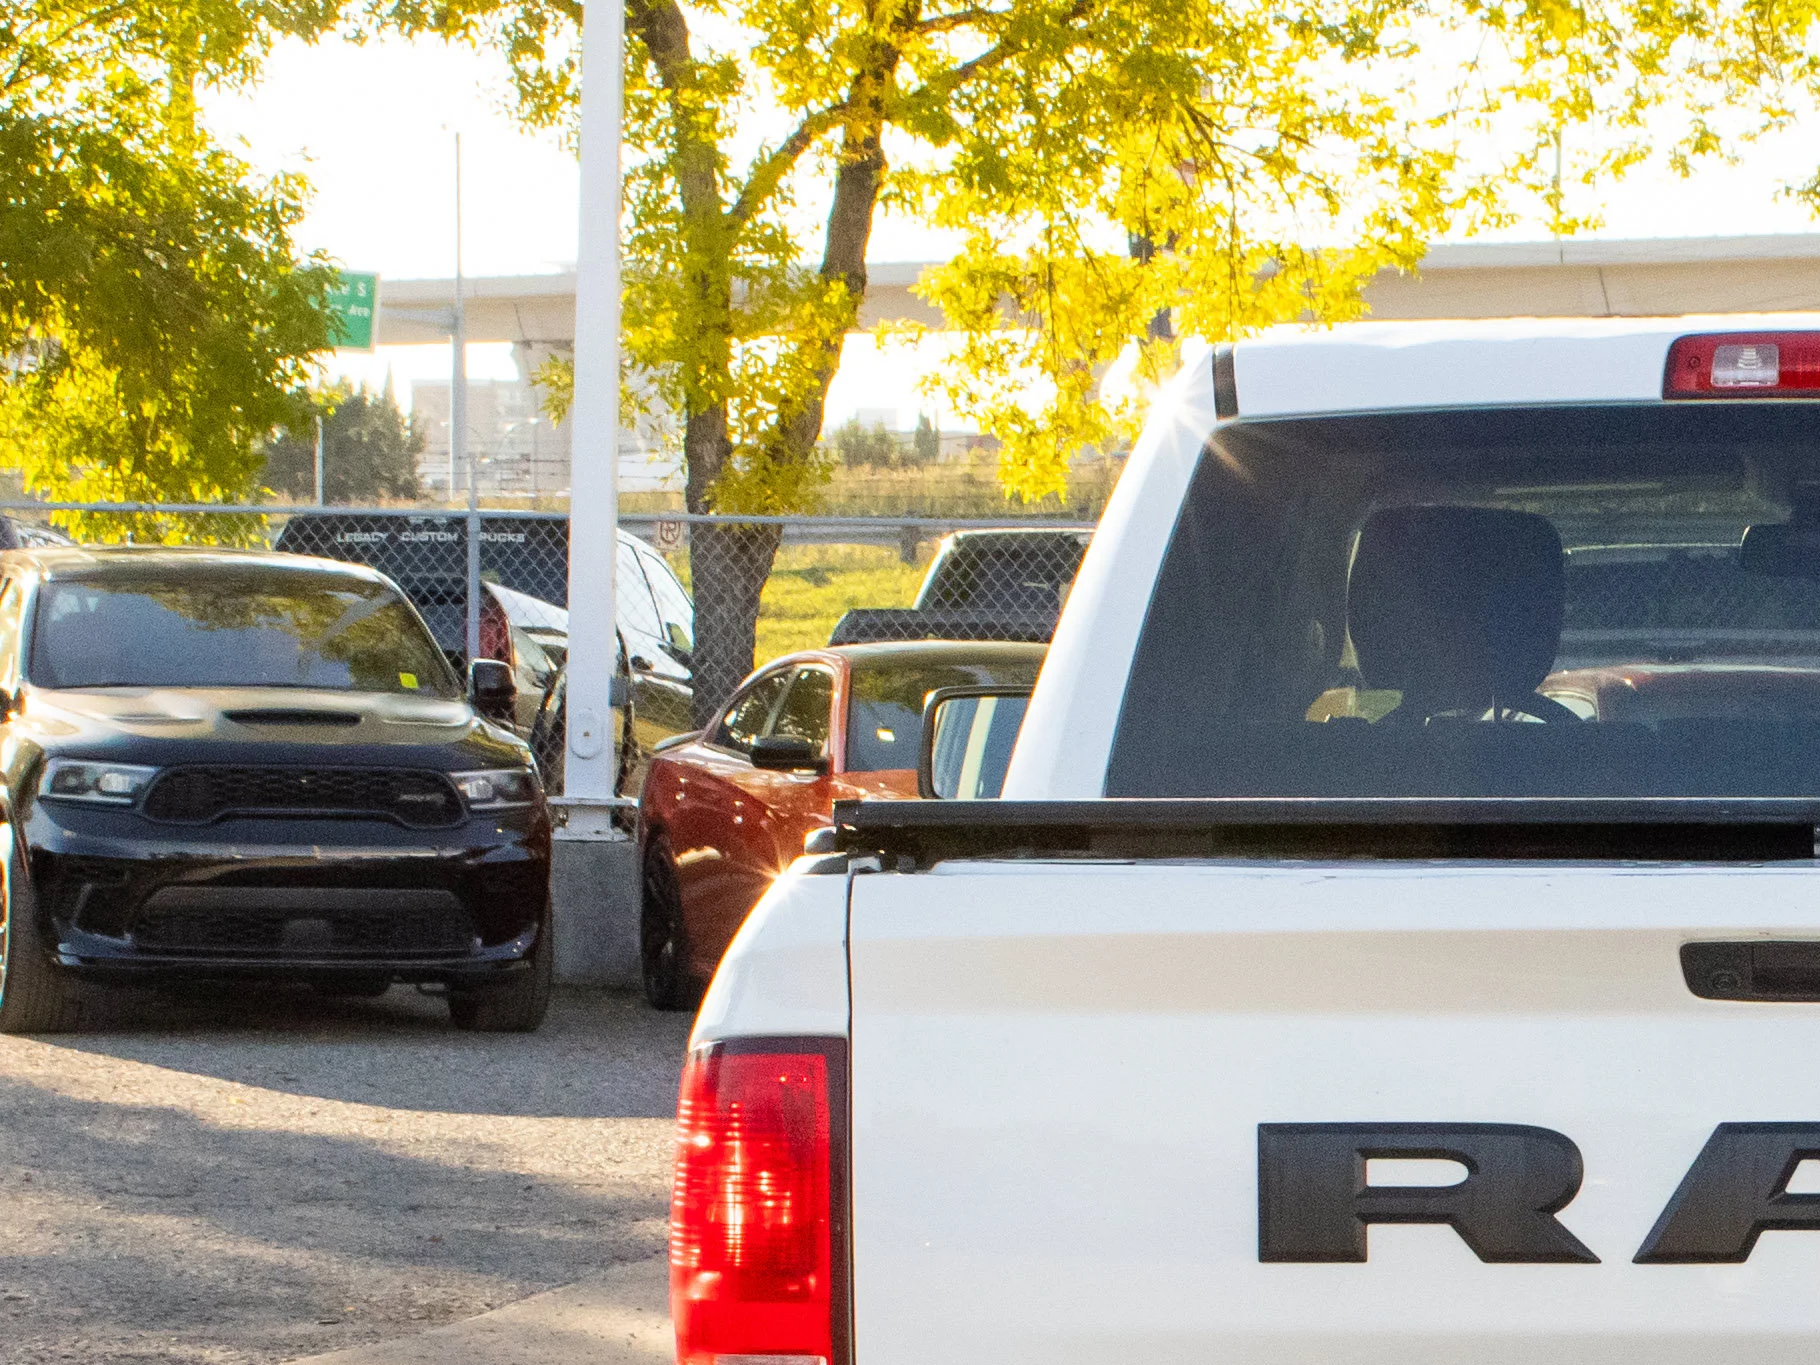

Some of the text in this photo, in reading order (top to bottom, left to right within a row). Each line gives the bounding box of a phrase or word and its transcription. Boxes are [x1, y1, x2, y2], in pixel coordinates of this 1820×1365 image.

[336, 531, 526, 543] LEGACY CUSTOM RUCKS
